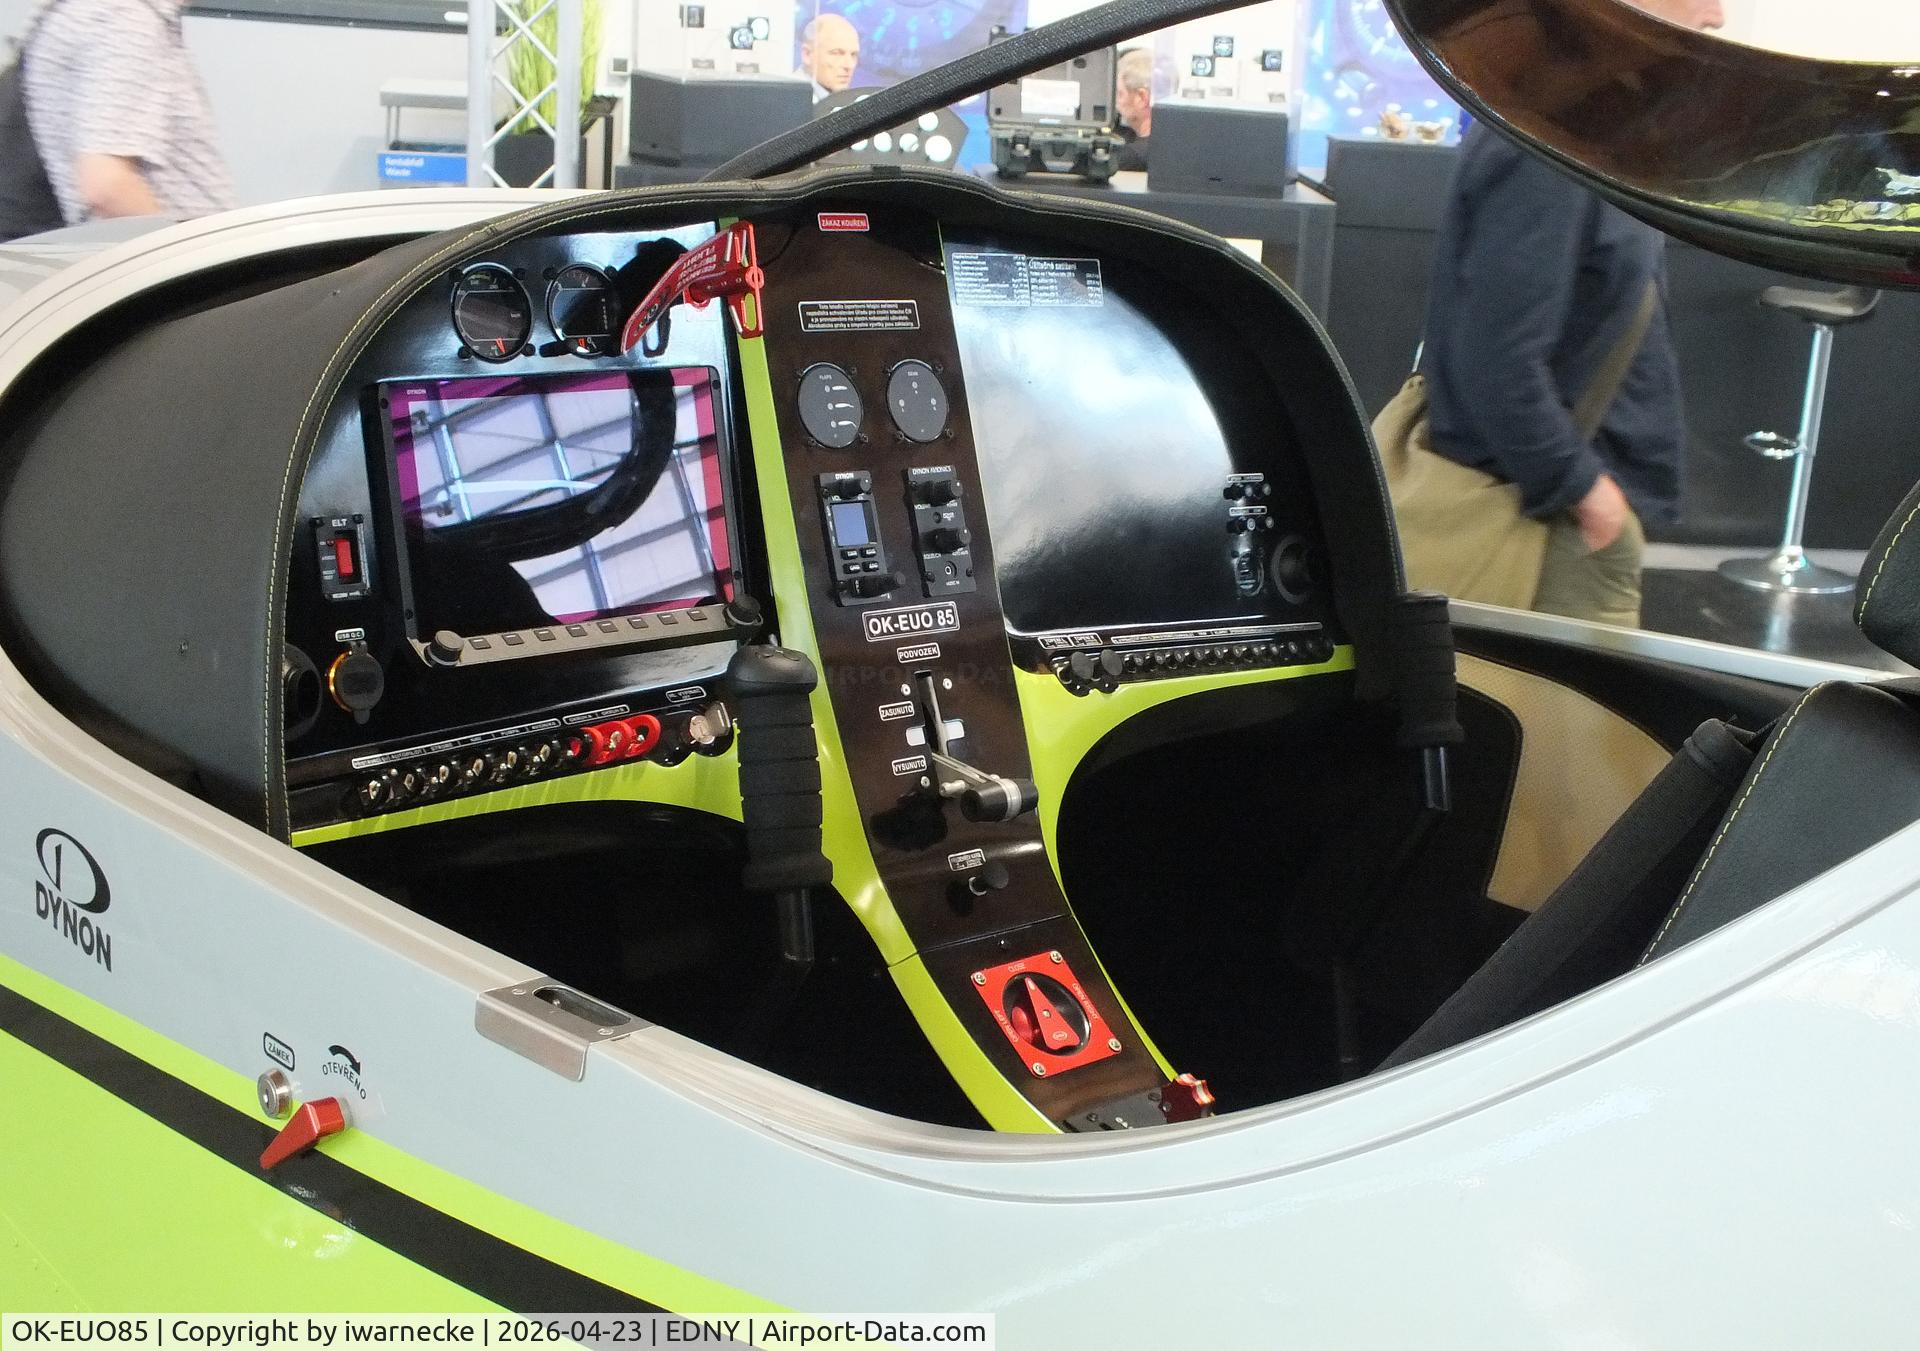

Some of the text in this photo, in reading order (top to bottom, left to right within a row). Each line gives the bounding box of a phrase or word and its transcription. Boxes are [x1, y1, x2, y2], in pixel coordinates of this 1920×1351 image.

[911, 467, 930, 475] DYNON
[331, 518, 348, 527] ELT
[868, 608, 956, 636] OK-EUO 85
[899, 645, 939, 659] PODVOZEK
[880, 705, 914, 719] ZASUNUTO
[894, 759, 926, 773] VYSUNUTO
[35, 879, 112, 973] DYNON
[1007, 963, 1027, 973] CLOSE
[267, 1042, 290, 1063] ZÁMEK
[322, 1061, 367, 1100] OTEVŘENO
